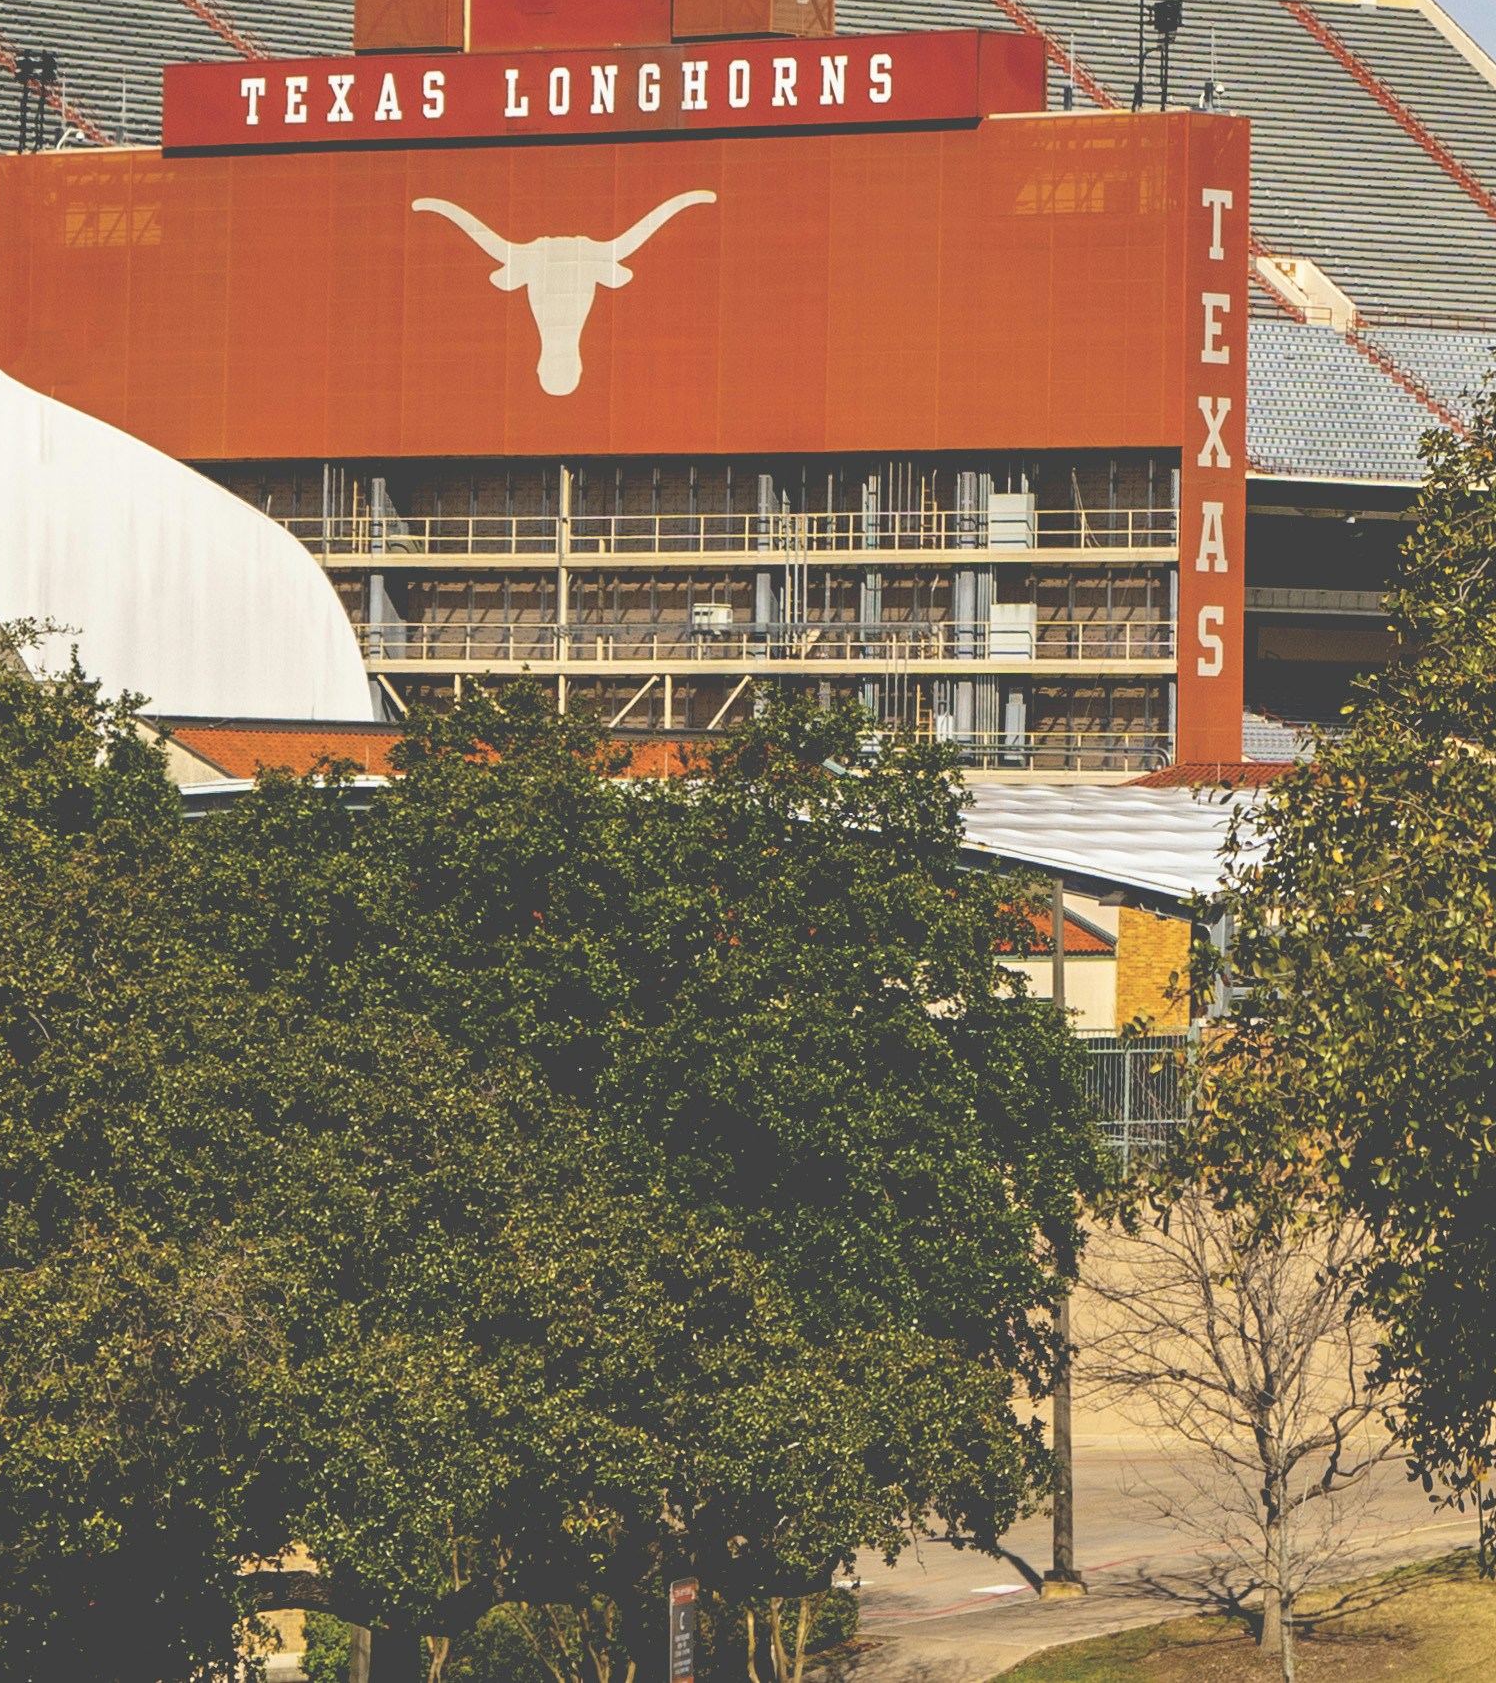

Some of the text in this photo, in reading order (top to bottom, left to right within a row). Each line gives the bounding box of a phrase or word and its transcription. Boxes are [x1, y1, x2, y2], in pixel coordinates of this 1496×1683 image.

[241, 54, 892, 125] TEXAS LONGHORNS
[1196, 188, 1233, 676] TEXAS
